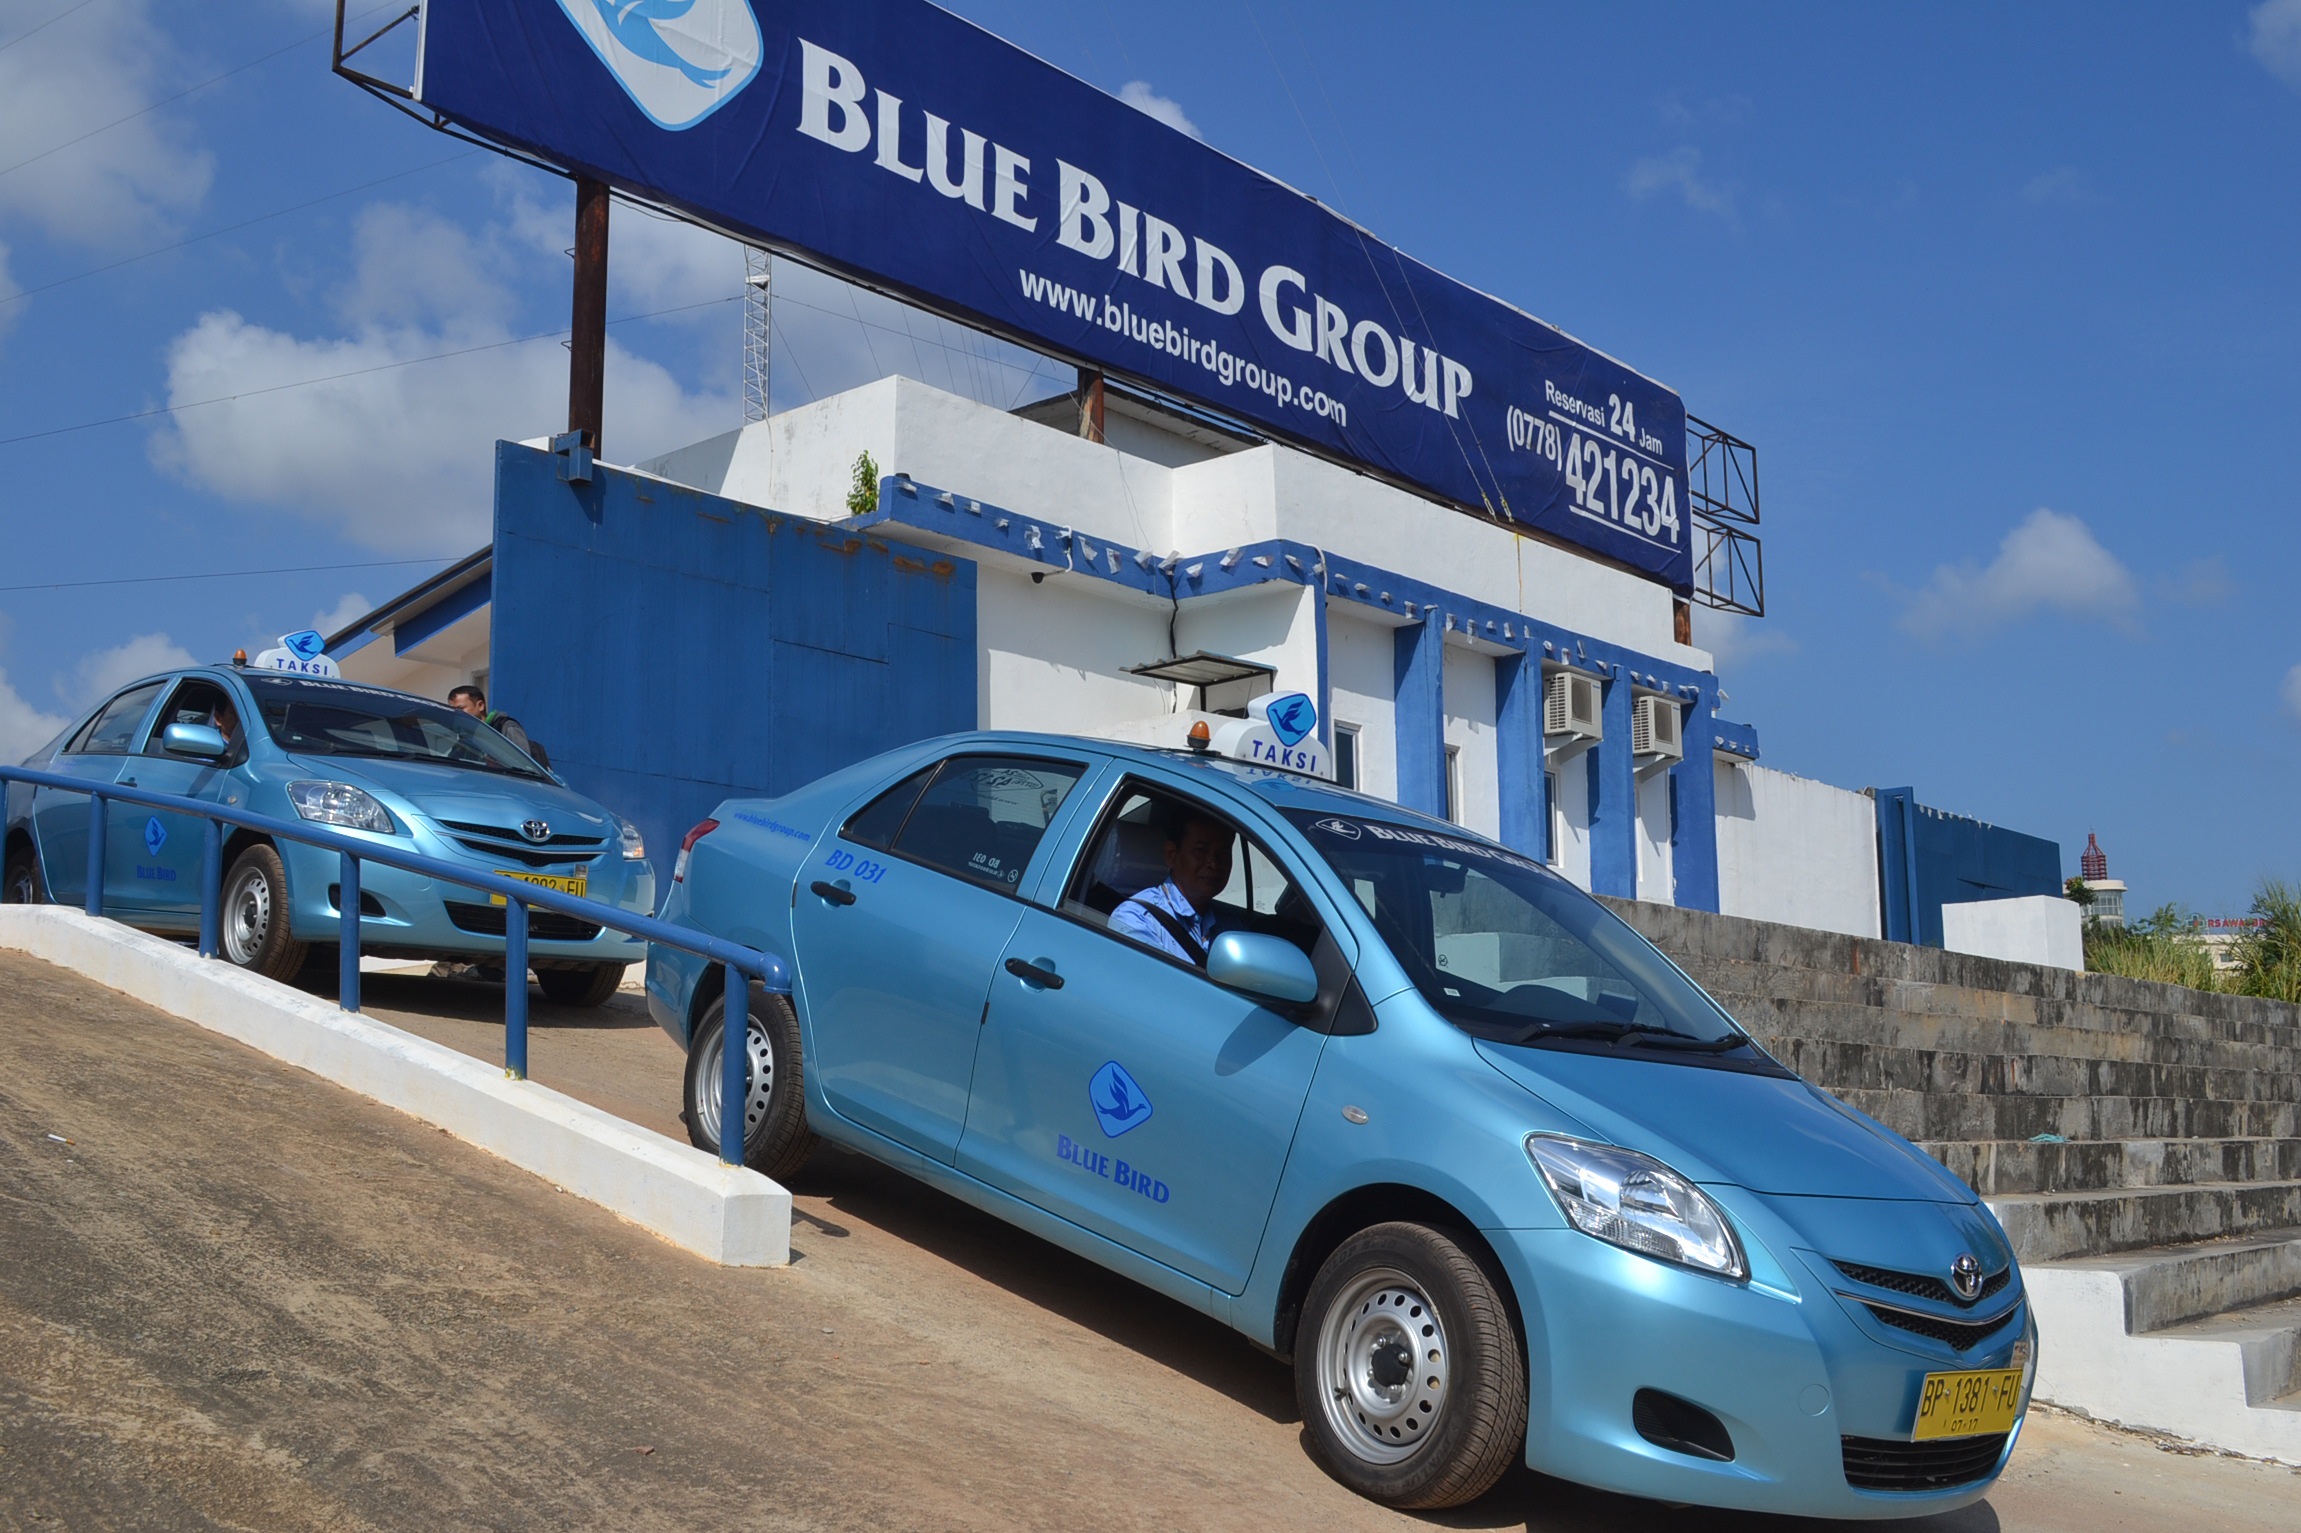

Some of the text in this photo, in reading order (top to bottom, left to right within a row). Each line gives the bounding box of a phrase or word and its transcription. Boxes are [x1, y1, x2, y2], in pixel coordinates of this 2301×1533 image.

[796, 37, 1473, 420] BLUE BIRD GROUP
[1019, 269, 1347, 427] www.bluebirdgroup.com
[1545, 379, 1663, 455] Reservasi 24 Jam
[1507, 405, 1680, 544] (0778) 421234
[276, 658, 328, 676] TAKSI
[1253, 740, 1316, 772] TAKSI
[734, 811, 811, 842] www.bluebirdgroup.com
[1363, 824, 1437, 847] BLUE
[1430, 835, 1492, 859] BIRD
[136, 865, 177, 882] BLUE BIRD
[825, 849, 887, 884] BD 031
[2207, 918, 2222, 928] RS
[1057, 1134, 1170, 1204] BLUE BIRD
[1921, 1375, 2022, 1416] BP 1381 FU
